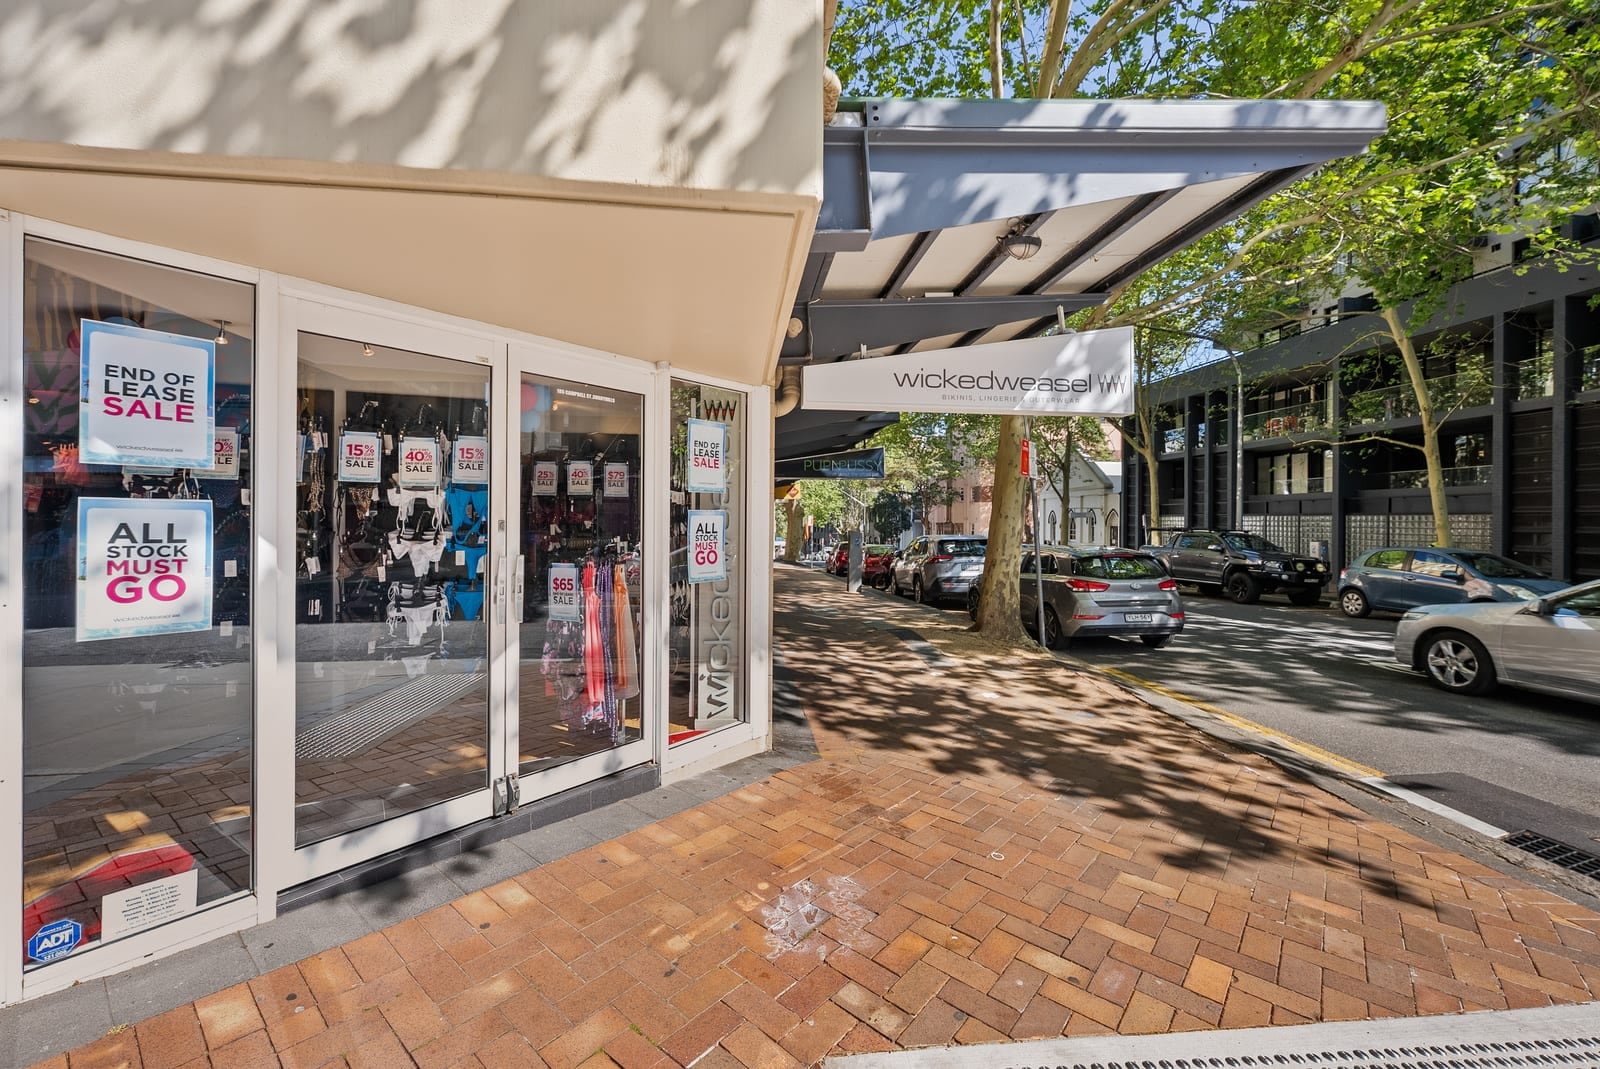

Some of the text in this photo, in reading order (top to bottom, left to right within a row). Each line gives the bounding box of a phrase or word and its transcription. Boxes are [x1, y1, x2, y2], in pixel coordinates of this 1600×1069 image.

[104, 364, 195, 387] END OF
[893, 368, 1092, 393] wickedweasel
[104, 379, 195, 404] LEASE
[979, 395, 1017, 403] LINGERIE
[103, 396, 194, 423] SALE
[215, 441, 233, 453] 0%
[346, 444, 375, 456] 15%
[694, 440, 708, 448] END
[405, 451, 432, 462] 40%
[459, 447, 484, 460] 15%
[694, 448, 720, 459] LEASE
[214, 457, 232, 465] LE
[345, 460, 374, 468] SALE
[458, 462, 484, 471] SALE
[693, 457, 720, 469] SALE
[405, 465, 432, 473] SALE
[608, 471, 625, 480] $79
[107, 523, 187, 544] ALL
[695, 522, 718, 534] ALL
[695, 534, 718, 542] STOCK
[106, 545, 188, 559] STOCK
[695, 541, 718, 551] MUST
[695, 550, 718, 566] GO
[106, 559, 188, 576] MUST
[106, 574, 187, 604] GO
[552, 577, 574, 592] $65
[553, 596, 574, 605] SALE
[38, 929, 72, 952] ADT
